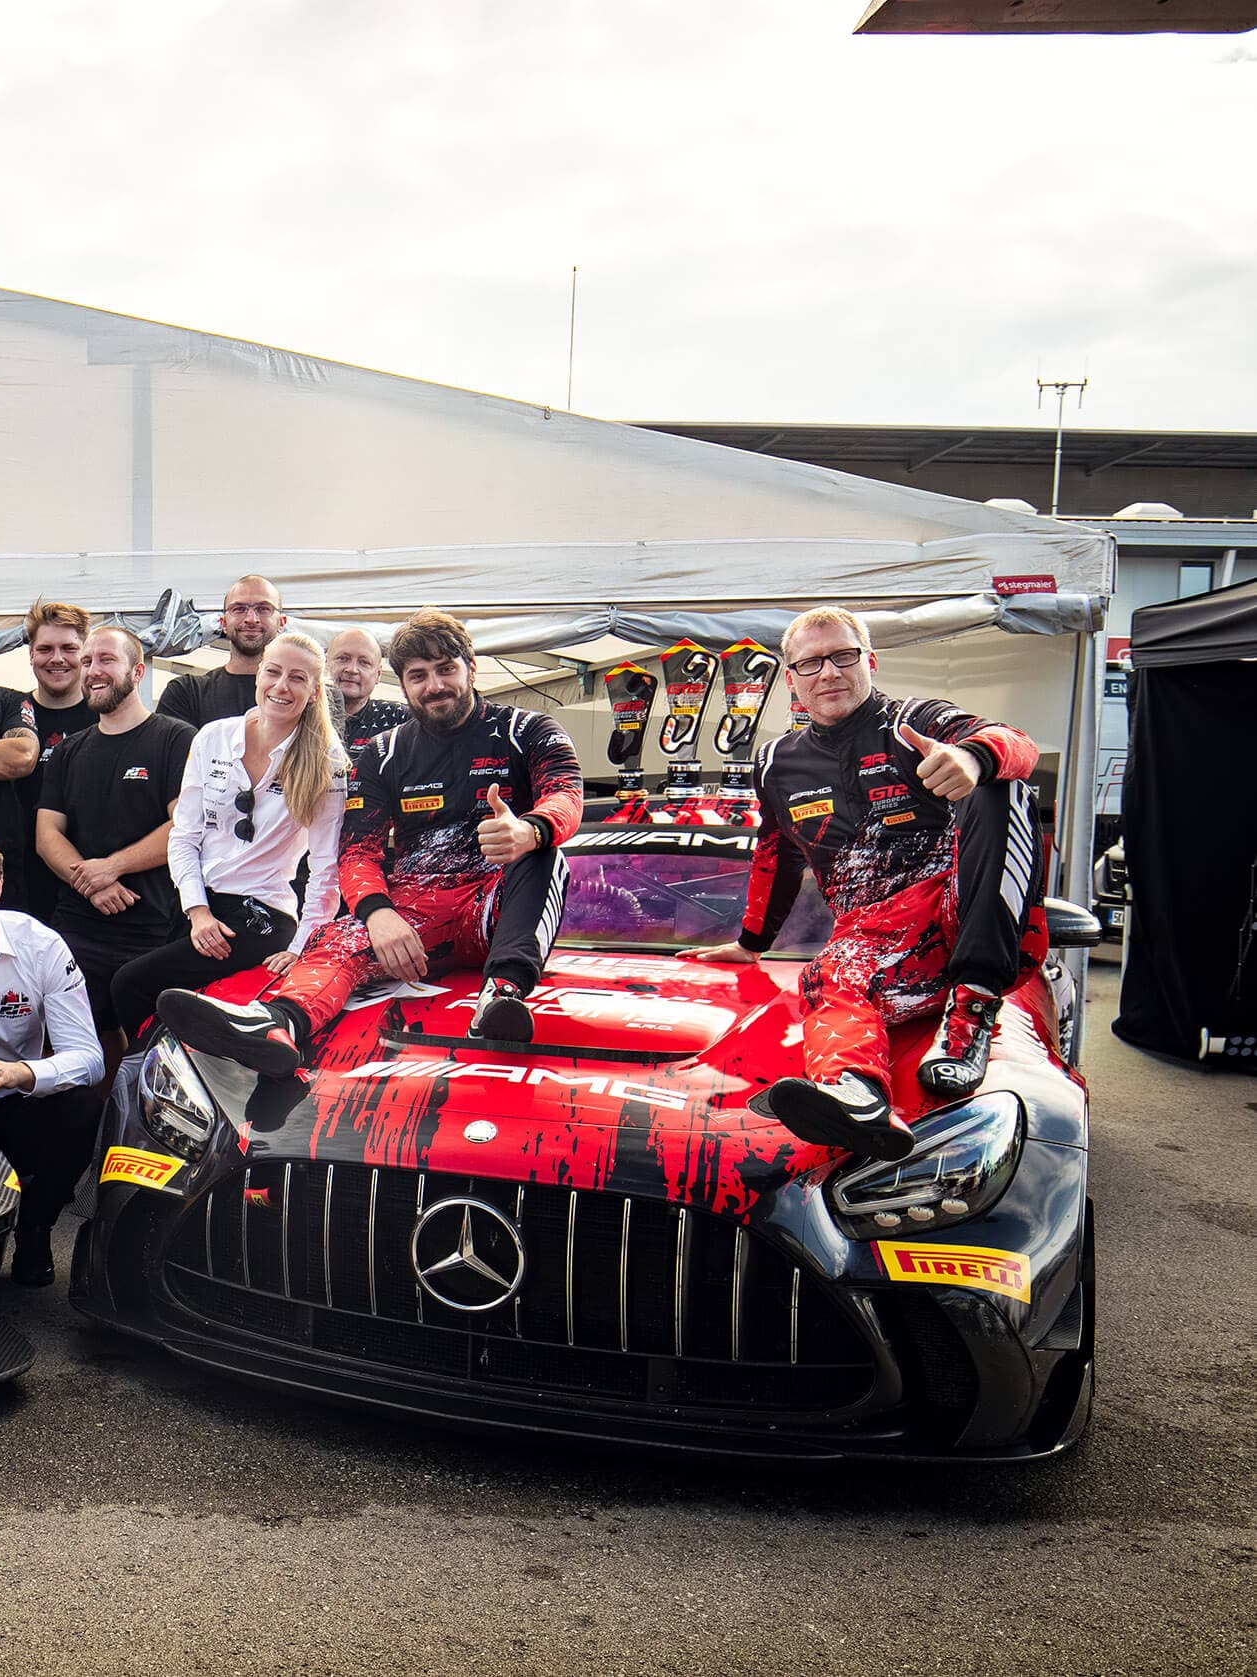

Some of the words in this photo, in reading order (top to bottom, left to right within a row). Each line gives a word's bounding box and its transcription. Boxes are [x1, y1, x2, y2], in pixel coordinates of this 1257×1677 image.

[476, 787, 513, 799] G2
[869, 784, 910, 801] GT2
[404, 798, 440, 810] PIRELLI
[792, 802, 830, 818] PIRELLI
[630, 831, 759, 850] AM
[440, 1062, 689, 1110] AMG
[103, 1153, 173, 1182] PIRELLI
[894, 1250, 1022, 1290] PIRELLI
